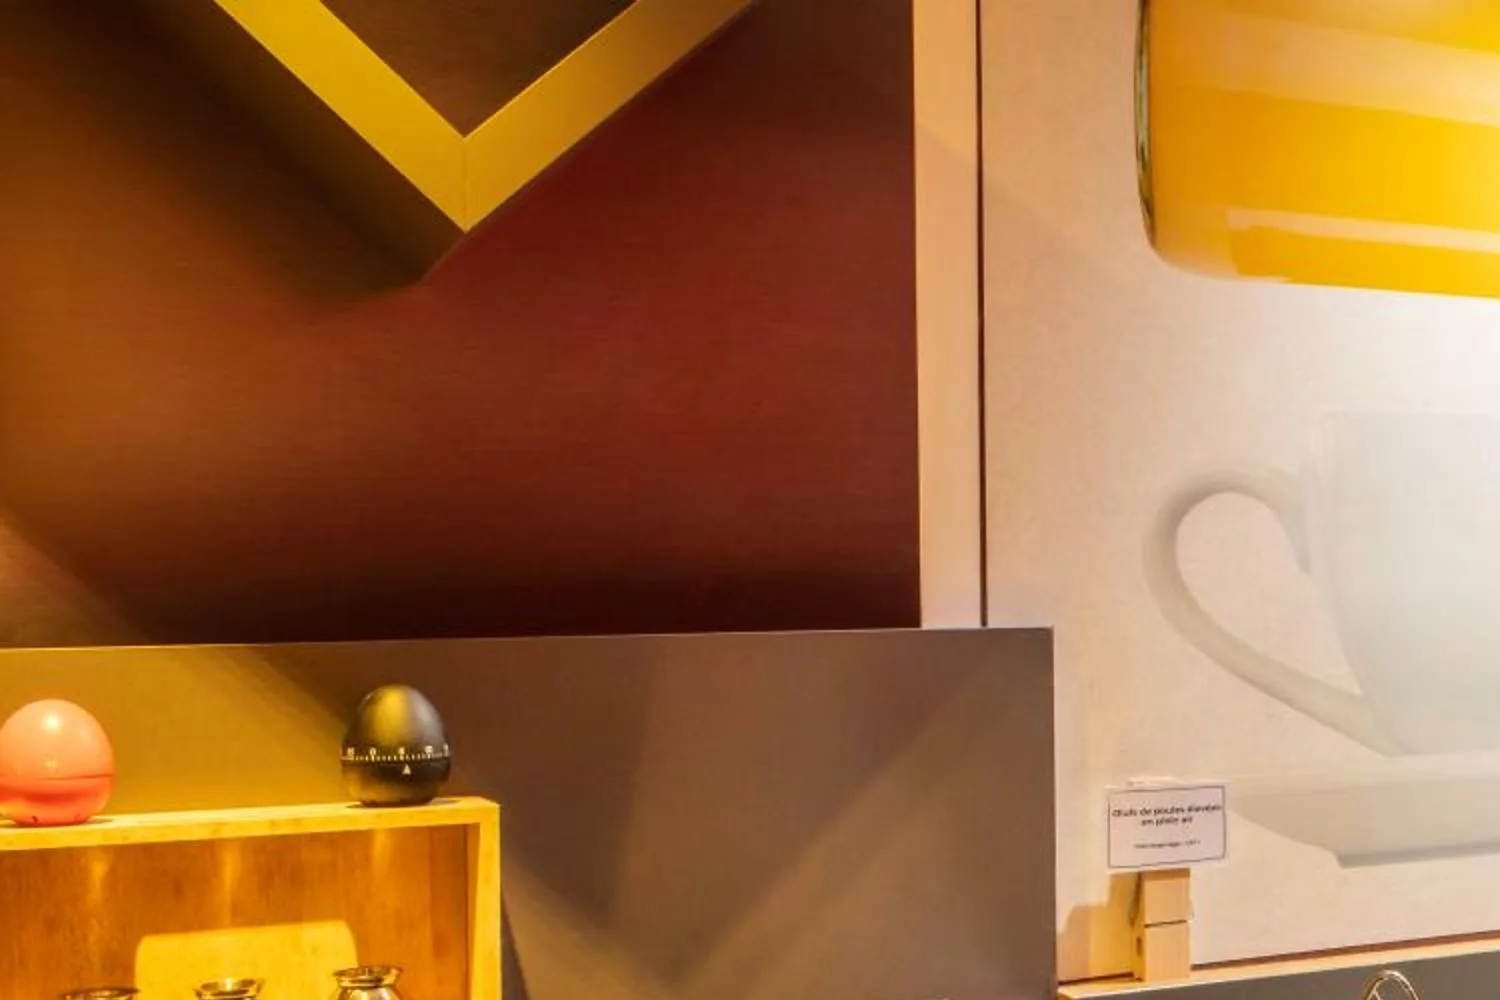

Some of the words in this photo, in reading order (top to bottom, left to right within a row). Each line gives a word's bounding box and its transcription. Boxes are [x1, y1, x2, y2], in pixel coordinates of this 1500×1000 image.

[1140, 807, 1152, 817] de
[1153, 805, 1185, 817] poules
[1141, 818, 1155, 826] en
[1155, 816, 1179, 827] plein
